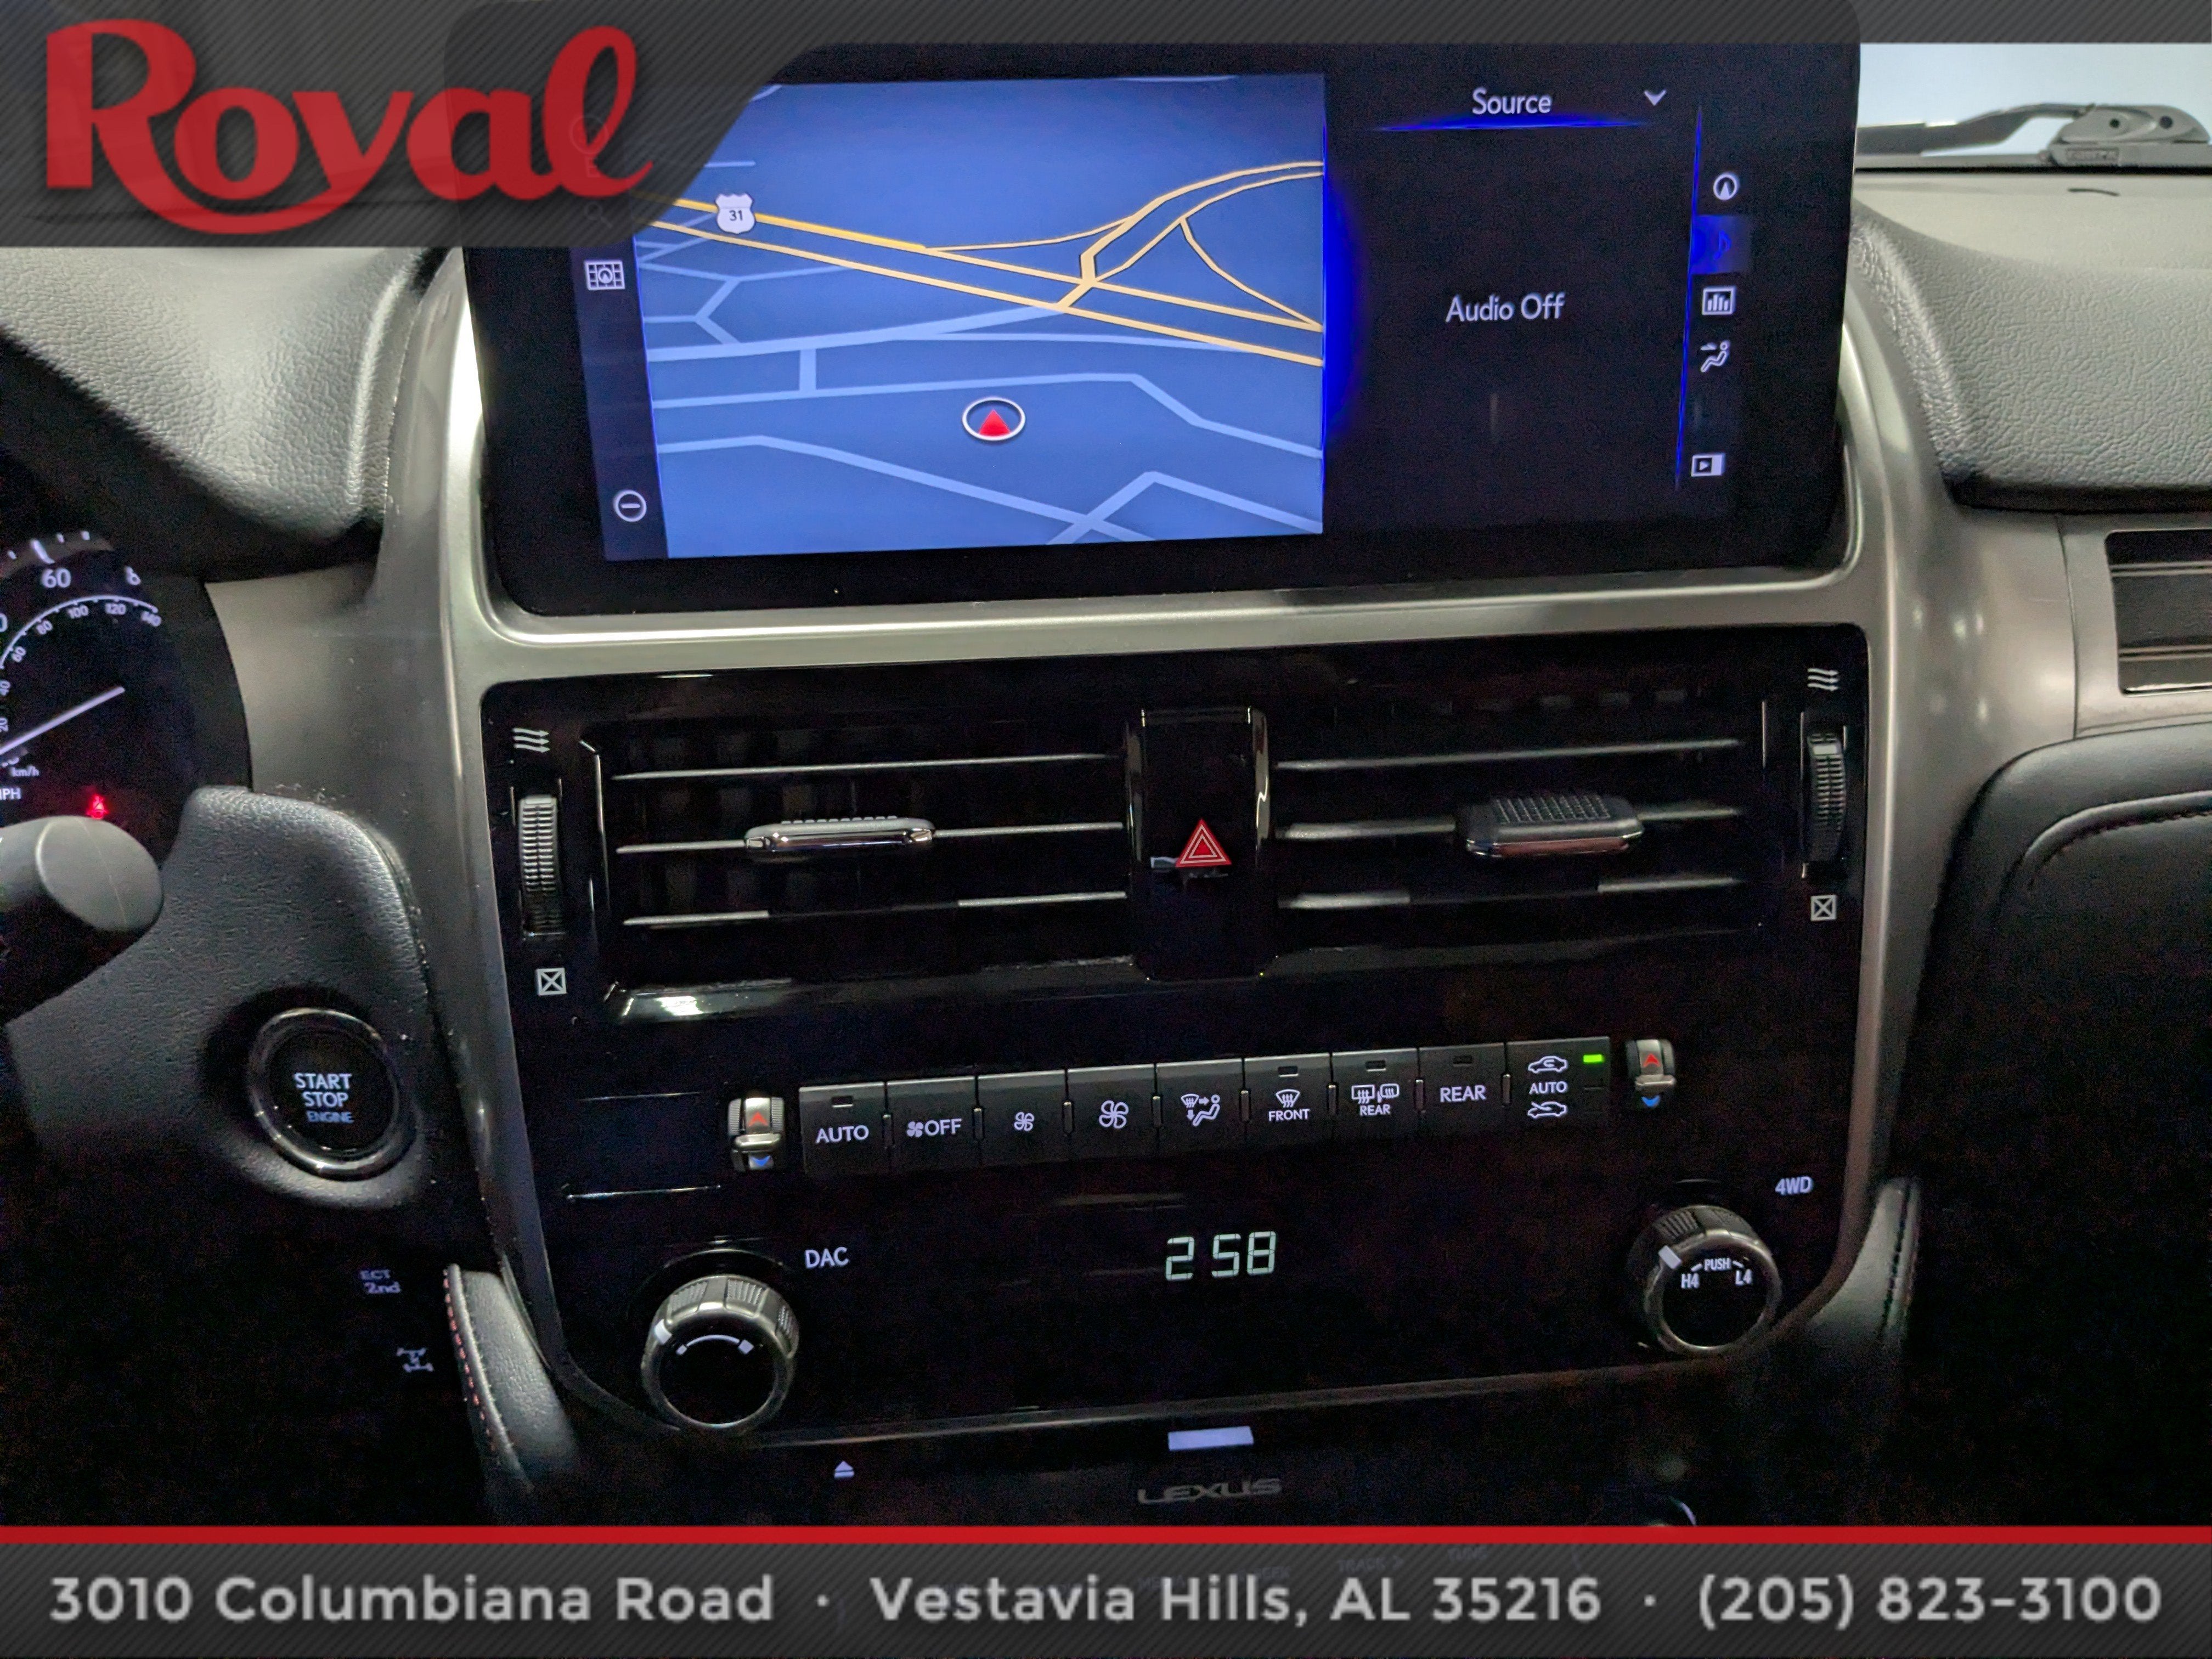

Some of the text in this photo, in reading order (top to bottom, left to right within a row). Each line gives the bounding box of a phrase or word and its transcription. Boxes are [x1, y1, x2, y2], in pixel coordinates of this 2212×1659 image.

[1472, 87, 1552, 115] Source
[729, 210, 743, 222] 31
[1445, 291, 1566, 323] Audio Off
[42, 567, 72, 589] 60
[11, 765, 40, 777] km/h
[294, 1072, 352, 1091] START
[1528, 1080, 1569, 1096] AUTO
[302, 1090, 349, 1108] STOP
[1440, 1085, 1487, 1103] REAR
[306, 1110, 356, 1124] ENGINE
[1268, 1108, 1311, 1122] FRONT
[1359, 1103, 1391, 1117] REAR
[815, 1124, 870, 1144] AUTO
[924, 1118, 963, 1137] OFF
[1775, 1176, 1814, 1196] 4WD
[804, 1246, 849, 1269] DAC
[1703, 1257, 1732, 1272] PUSH
[364, 1280, 402, 1294] 2nd
[1680, 1273, 1700, 1289] H4
[1735, 1270, 1752, 1286] L4
[1137, 1478, 1283, 1504] LEXUS
